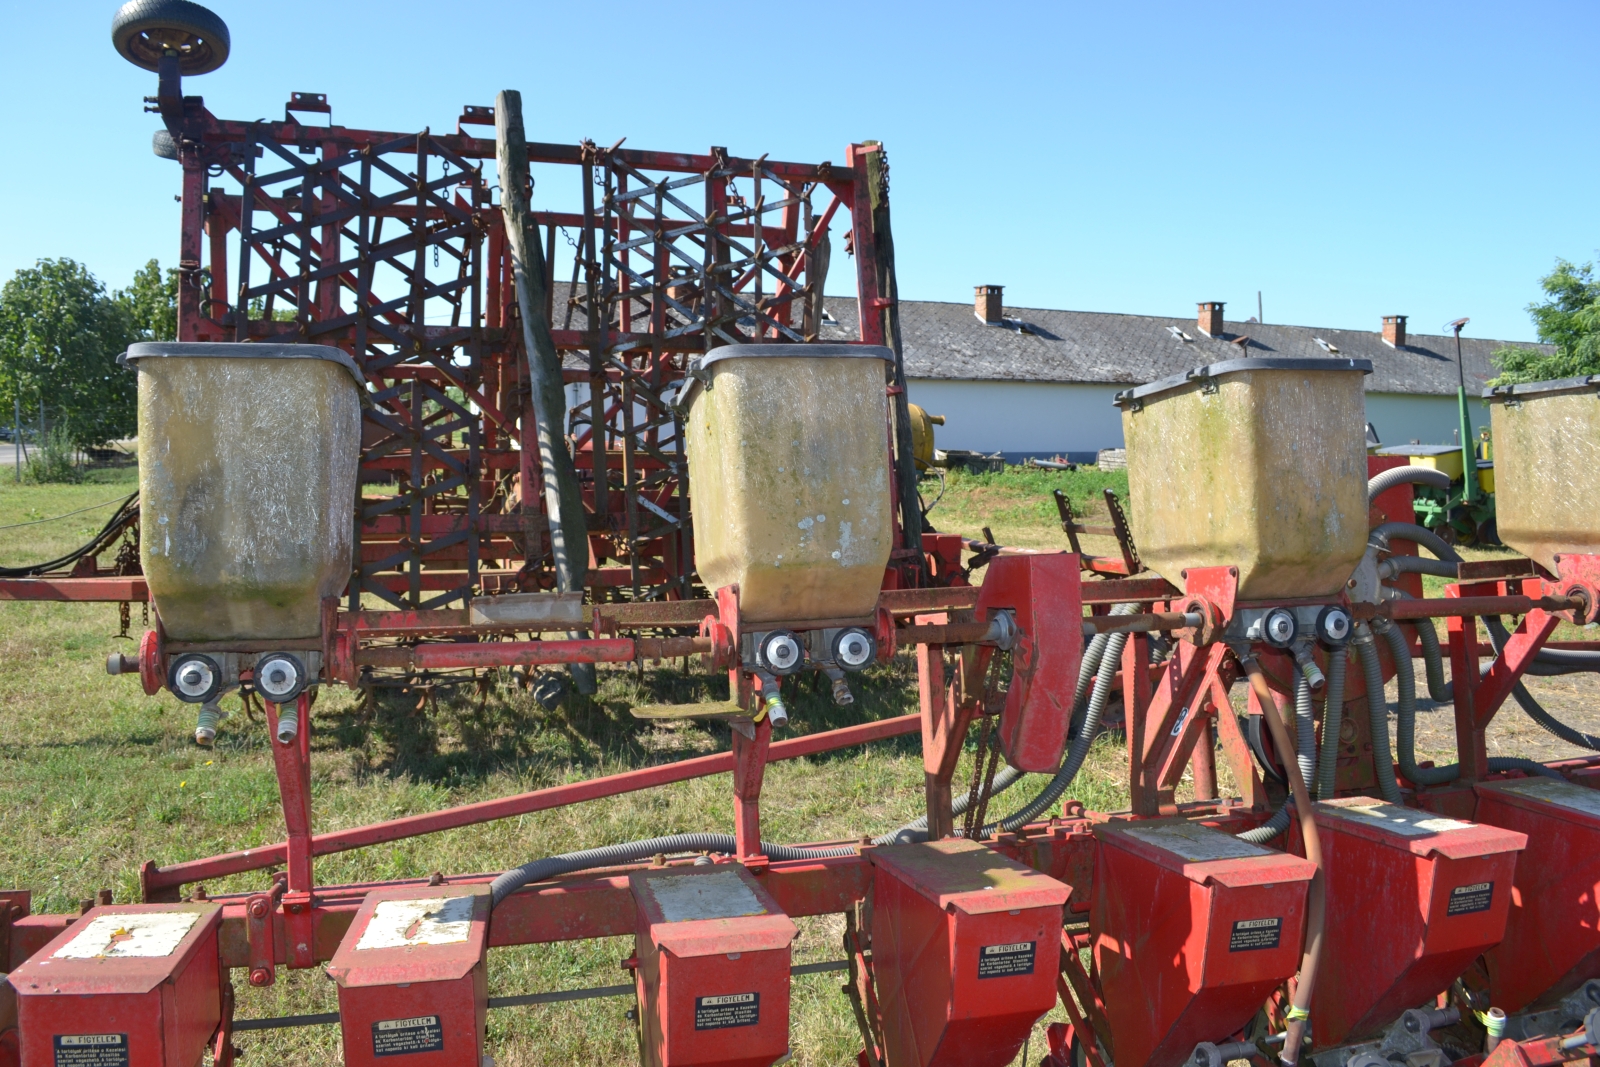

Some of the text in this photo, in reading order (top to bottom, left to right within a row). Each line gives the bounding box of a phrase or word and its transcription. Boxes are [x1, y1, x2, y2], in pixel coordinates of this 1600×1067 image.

[998, 944, 1027, 952] FIGYELEM
[717, 995, 750, 1004] FIGYELEM
[395, 1017, 431, 1027] FIGYELEM
